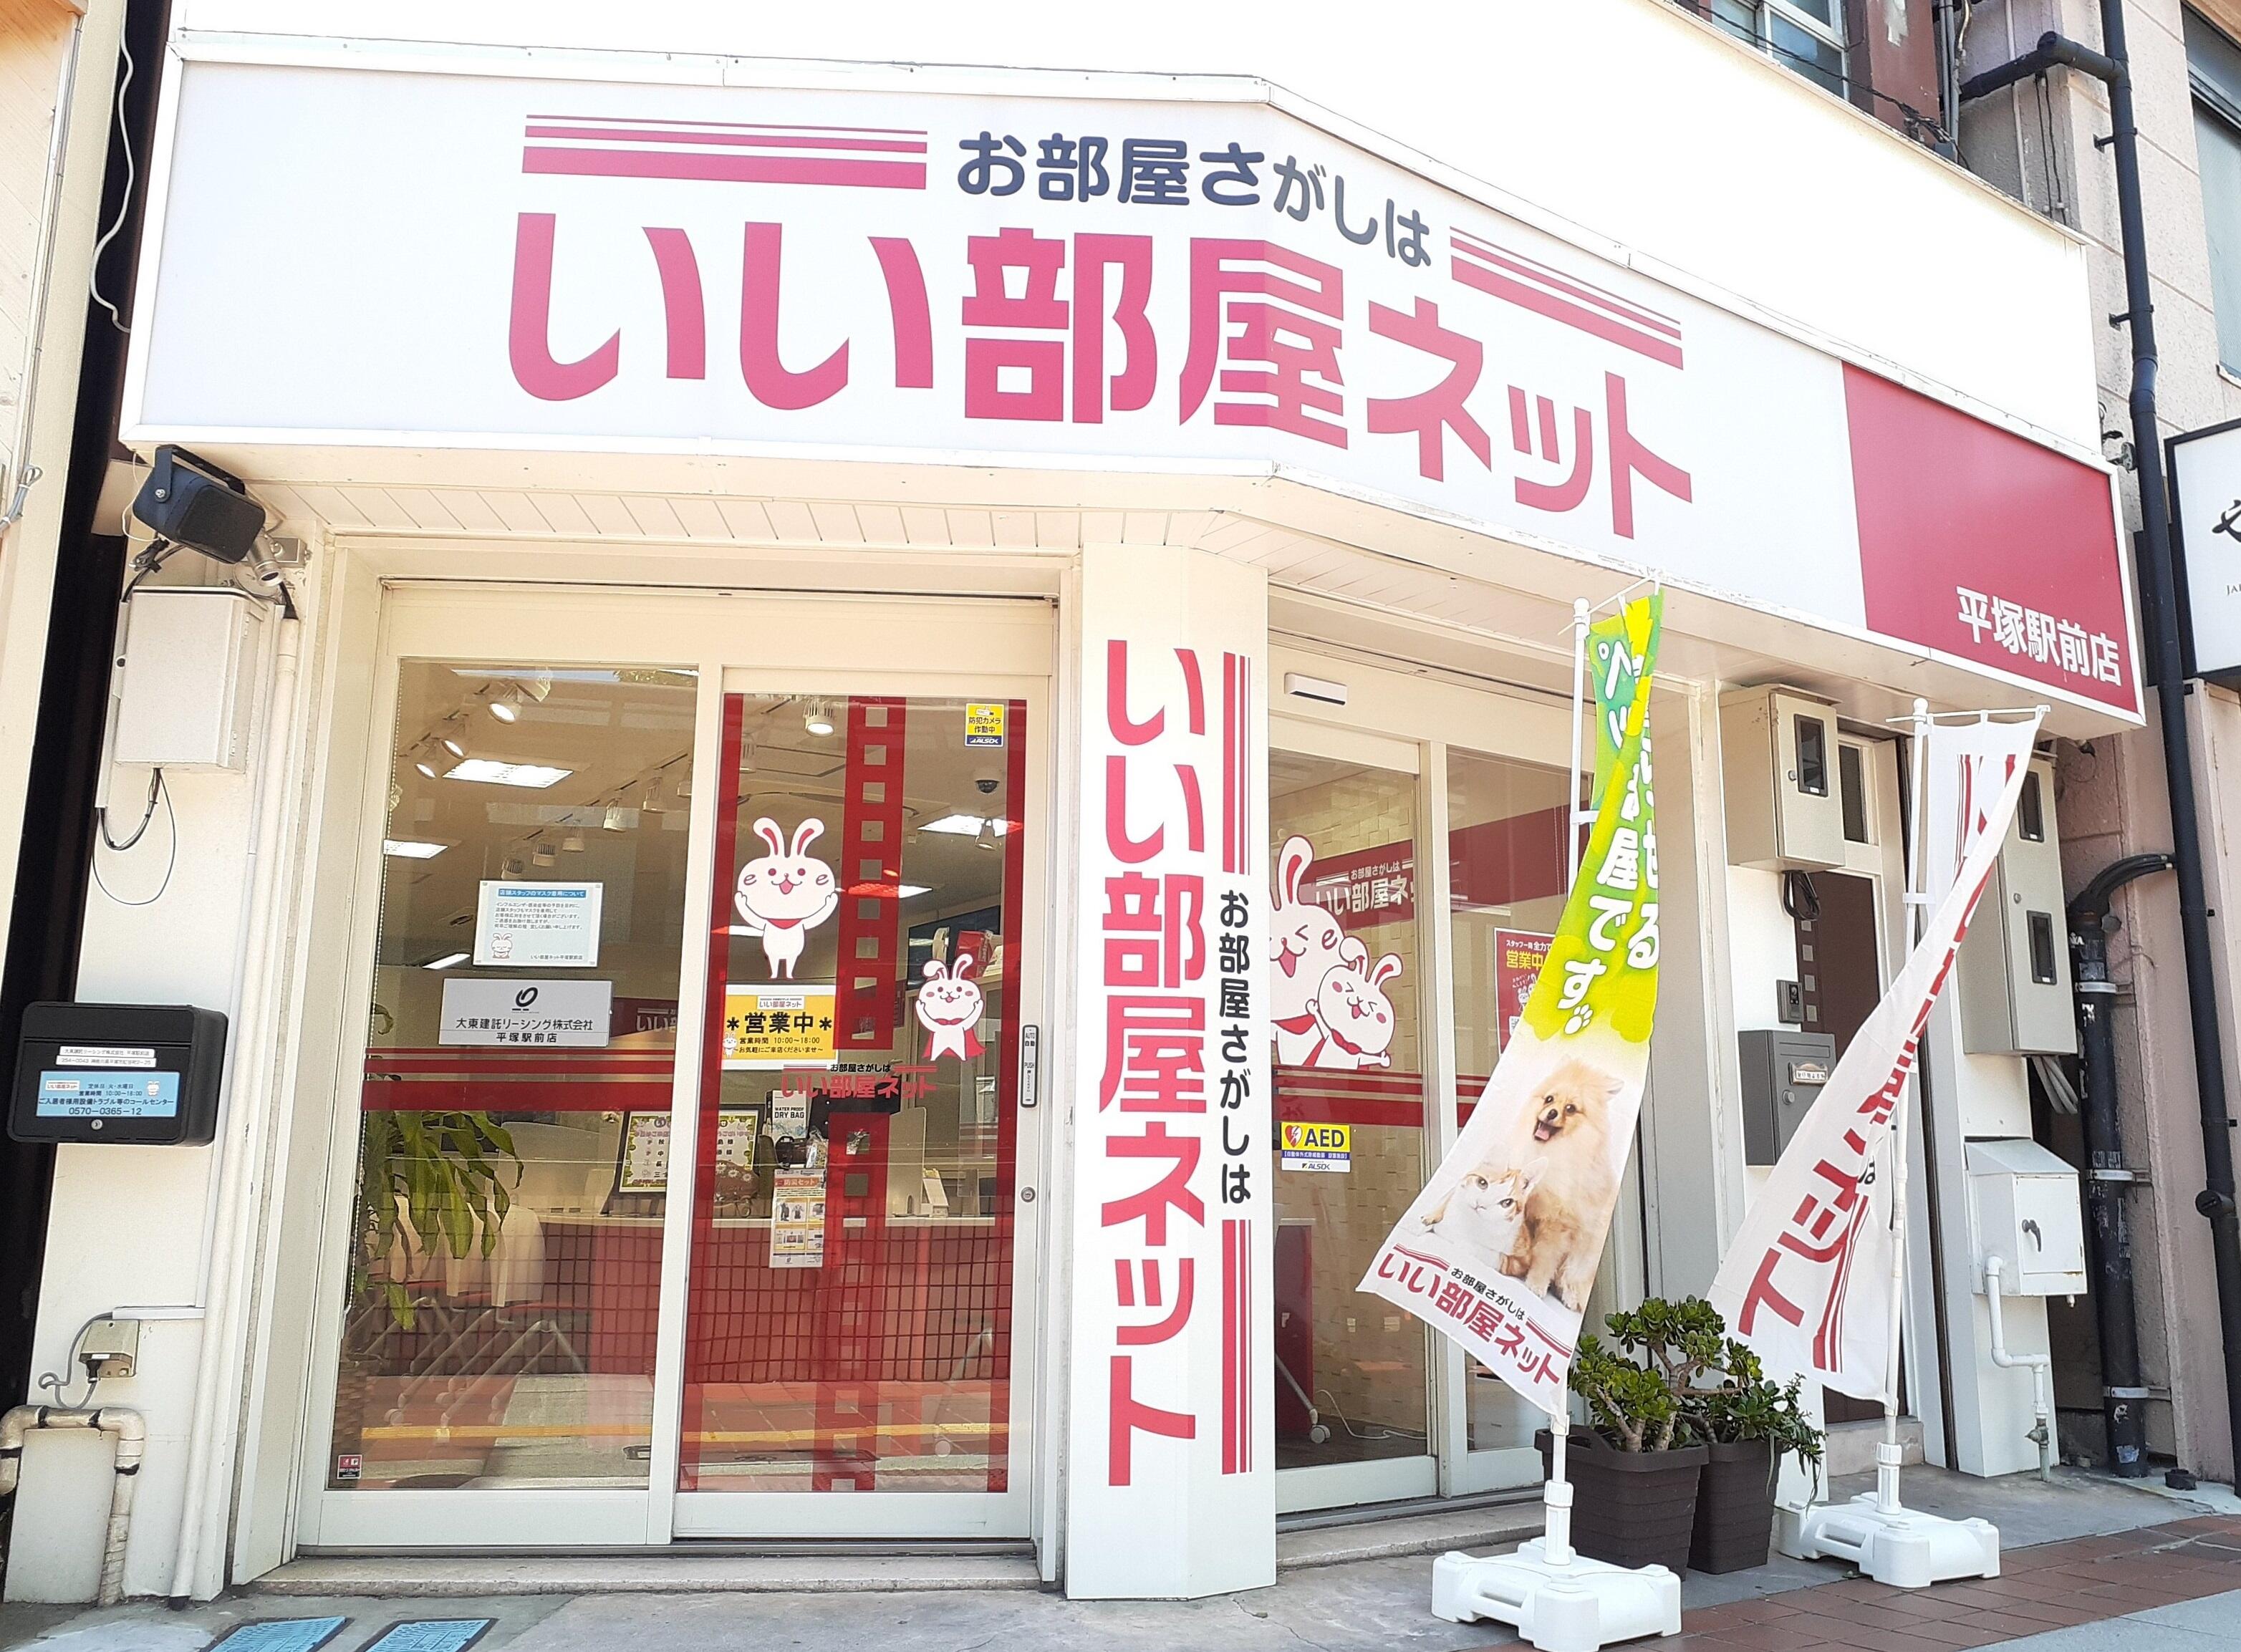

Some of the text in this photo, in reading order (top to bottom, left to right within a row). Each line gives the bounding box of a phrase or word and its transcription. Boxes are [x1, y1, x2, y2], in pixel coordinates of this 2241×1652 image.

[957, 131, 1431, 267] お部屋さがしは
[509, 212, 1692, 539] いい部屋ネット
[1956, 585, 2121, 686] 平塚駅前店
[1351, 861, 1400, 879] お部屋さがしは
[456, 1018, 593, 1030] 大東建託リーシング株式会社
[496, 1033, 557, 1043] 平塚駅前店
[1099, 639, 1207, 1486] いい部屋ネット
[1219, 889, 1251, 1204] お部屋さがしは
[781, 1076, 938, 1098] いい部屋ネット
[1304, 1129, 1344, 1148] AED
[1377, 1253, 1560, 1384] いい部屋ネット
[1451, 1267, 1525, 1321] お部屋さがしは
